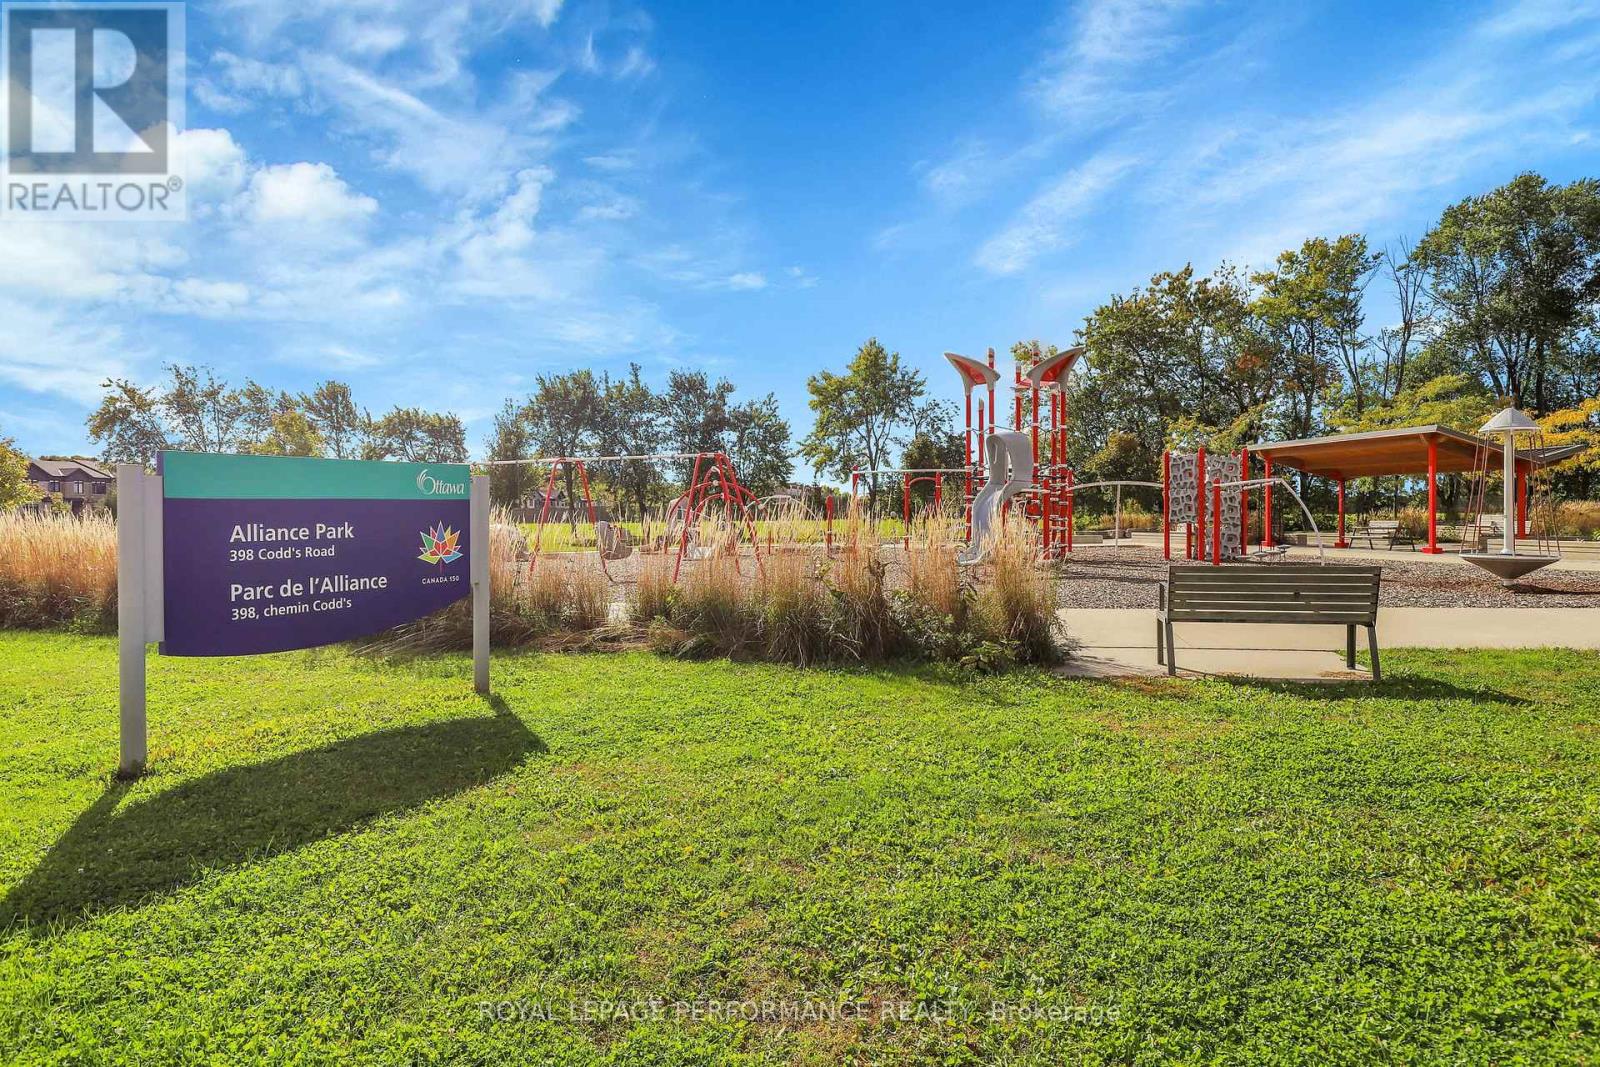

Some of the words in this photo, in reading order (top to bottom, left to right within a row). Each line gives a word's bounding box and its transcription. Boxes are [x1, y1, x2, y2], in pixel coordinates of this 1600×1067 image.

[416, 468, 465, 495] Ottawa
[229, 523, 310, 543] Alliance
[315, 522, 355, 540] Park
[229, 550, 254, 562] 398
[258, 547, 301, 560] Codd's
[305, 545, 335, 558] Road
[230, 583, 274, 601] Parc
[279, 579, 304, 597] de
[421, 576, 448, 585] CANADA
[449, 575, 460, 583] 150
[231, 607, 260, 621] 398,
[263, 602, 309, 617] chemin
[313, 597, 352, 612] Codd's
